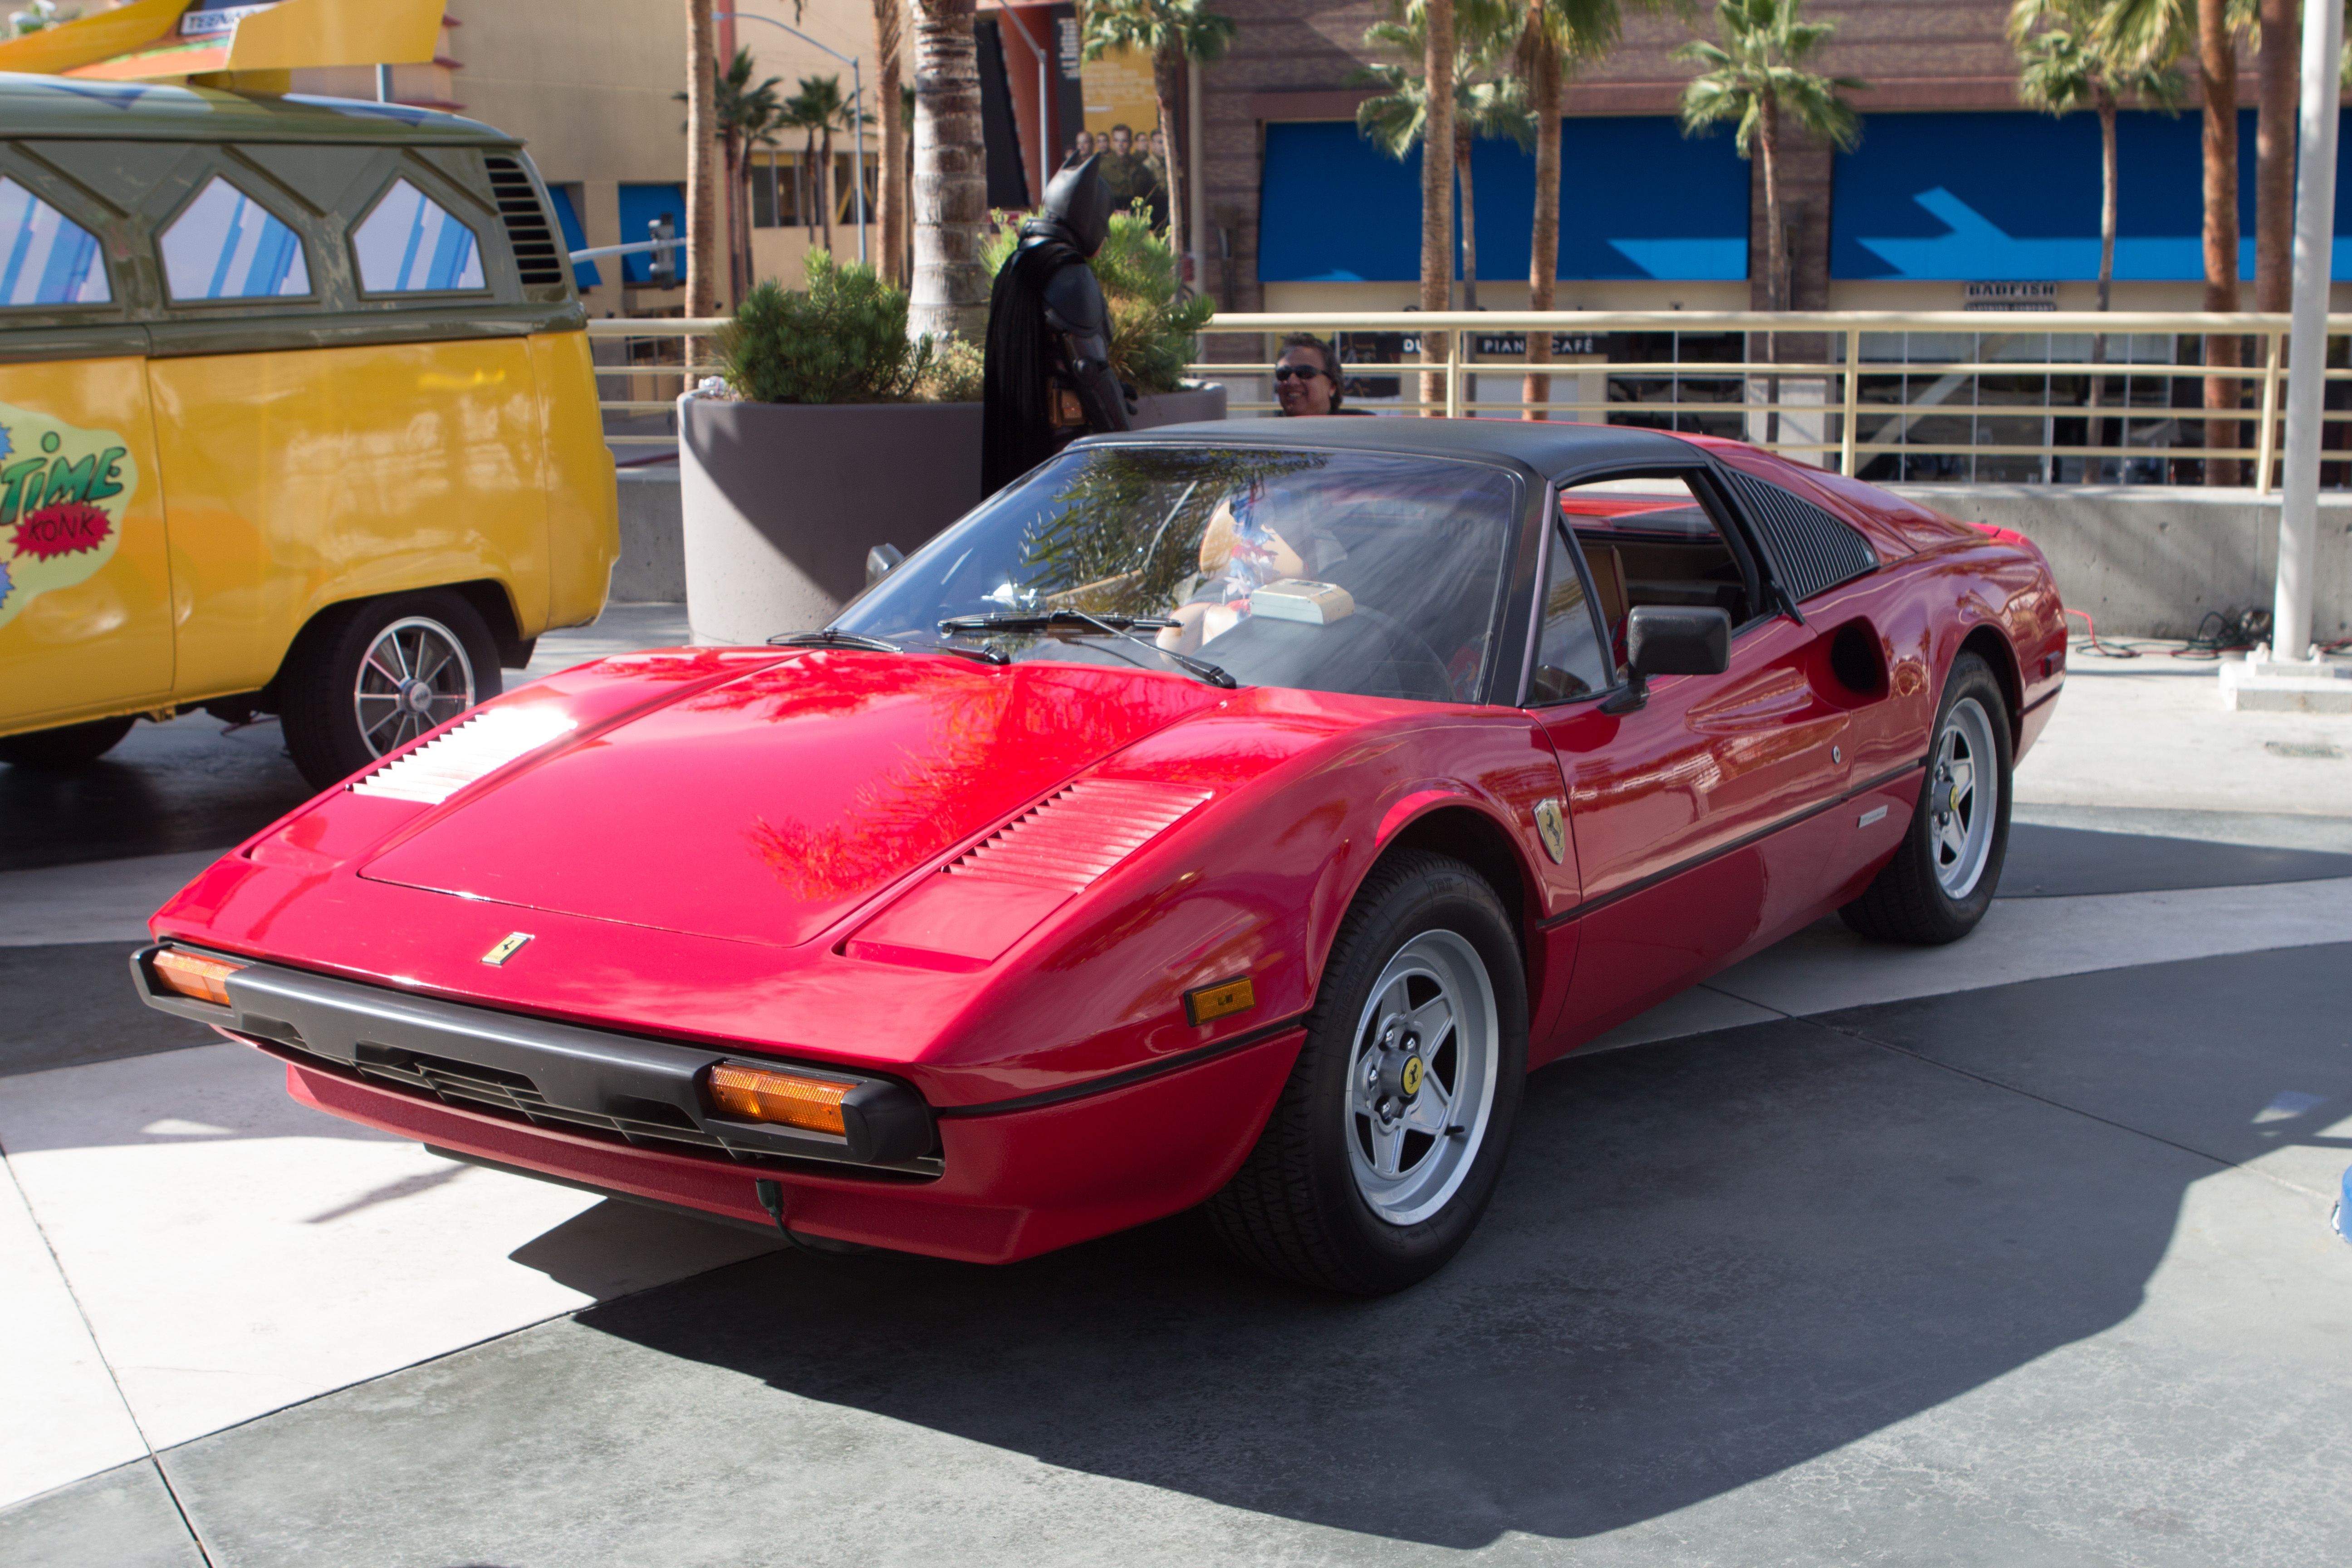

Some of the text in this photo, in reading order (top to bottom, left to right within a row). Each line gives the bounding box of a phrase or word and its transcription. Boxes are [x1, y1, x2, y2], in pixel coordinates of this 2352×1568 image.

[1483, 339, 1525, 353] PIAN
[28, 511, 95, 542] KONK
[1334, 936, 1379, 1032] MICHELIN
